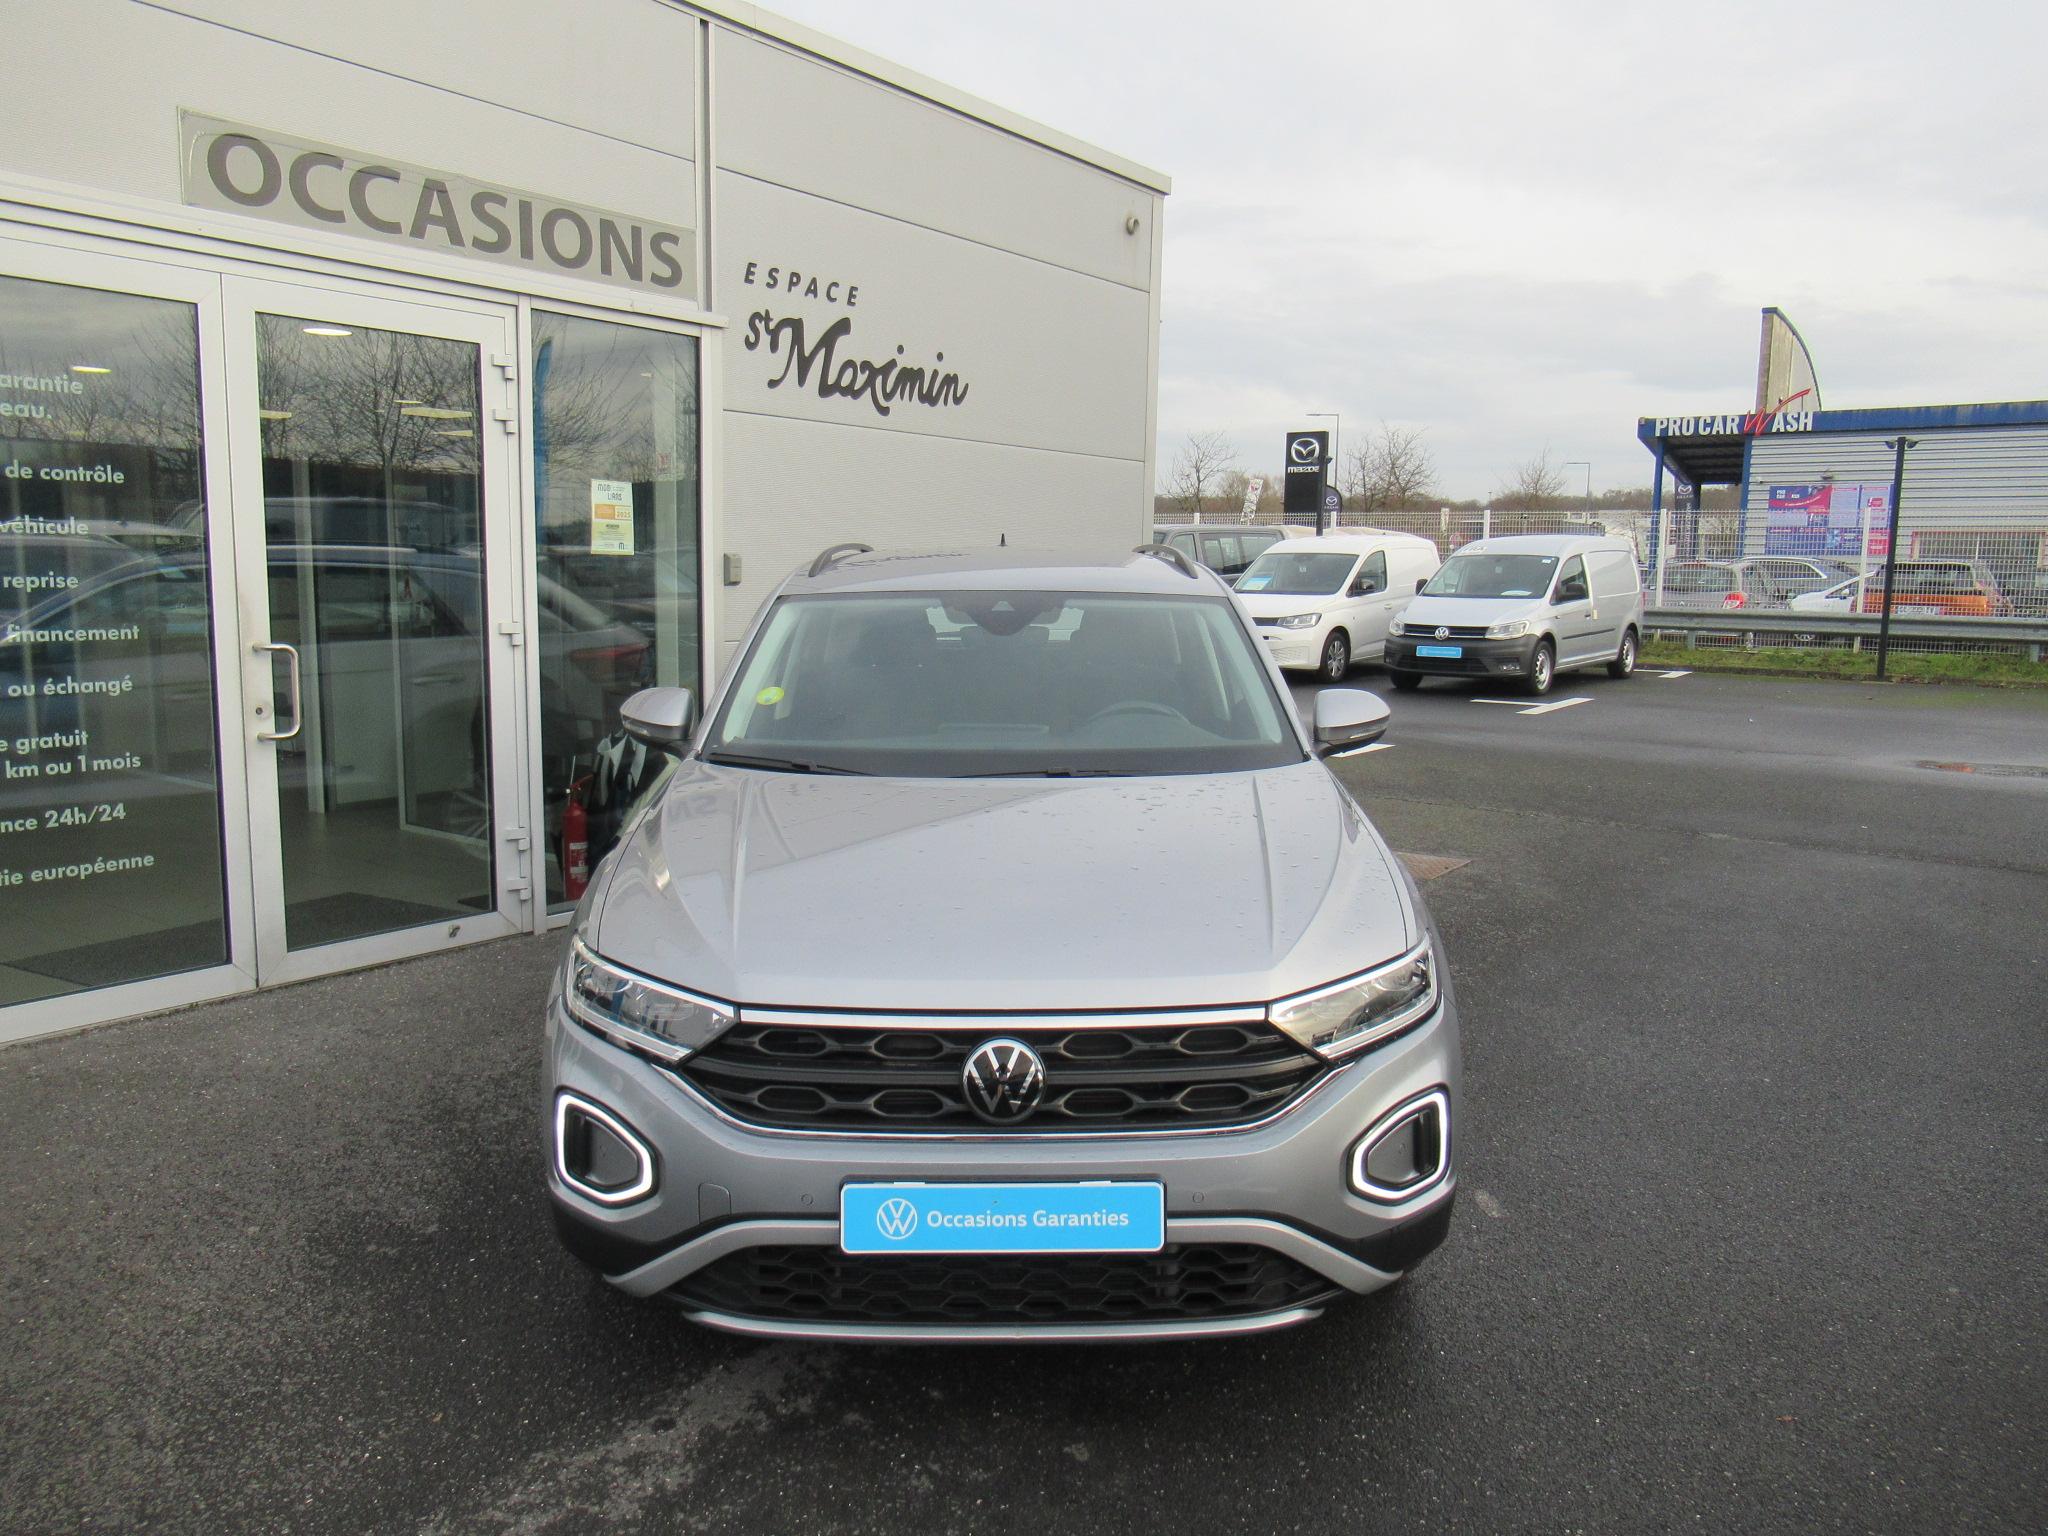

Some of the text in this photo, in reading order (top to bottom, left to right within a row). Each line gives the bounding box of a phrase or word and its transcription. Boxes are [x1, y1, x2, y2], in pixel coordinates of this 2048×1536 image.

[206, 132, 683, 288] OCCASIONS
[744, 262, 858, 306] ESPACE
[744, 309, 969, 416] St Maximin
[1655, 418, 1695, 437] PRO
[1699, 415, 1740, 435] CAR
[5, 459, 125, 484] de contrôle
[3, 571, 79, 593] reprise
[7, 623, 140, 643] financement
[8, 675, 133, 698] ou échangé
[16, 730, 88, 754] gratuit
[5, 752, 141, 779] km ou 1 mois
[0, 818, 38, 833] nce
[44, 803, 126, 829] 24h/24
[31, 854, 155, 882] européenne
[927, 1209, 1028, 1228] Occasions
[1033, 1209, 1129, 1228] Garanties
